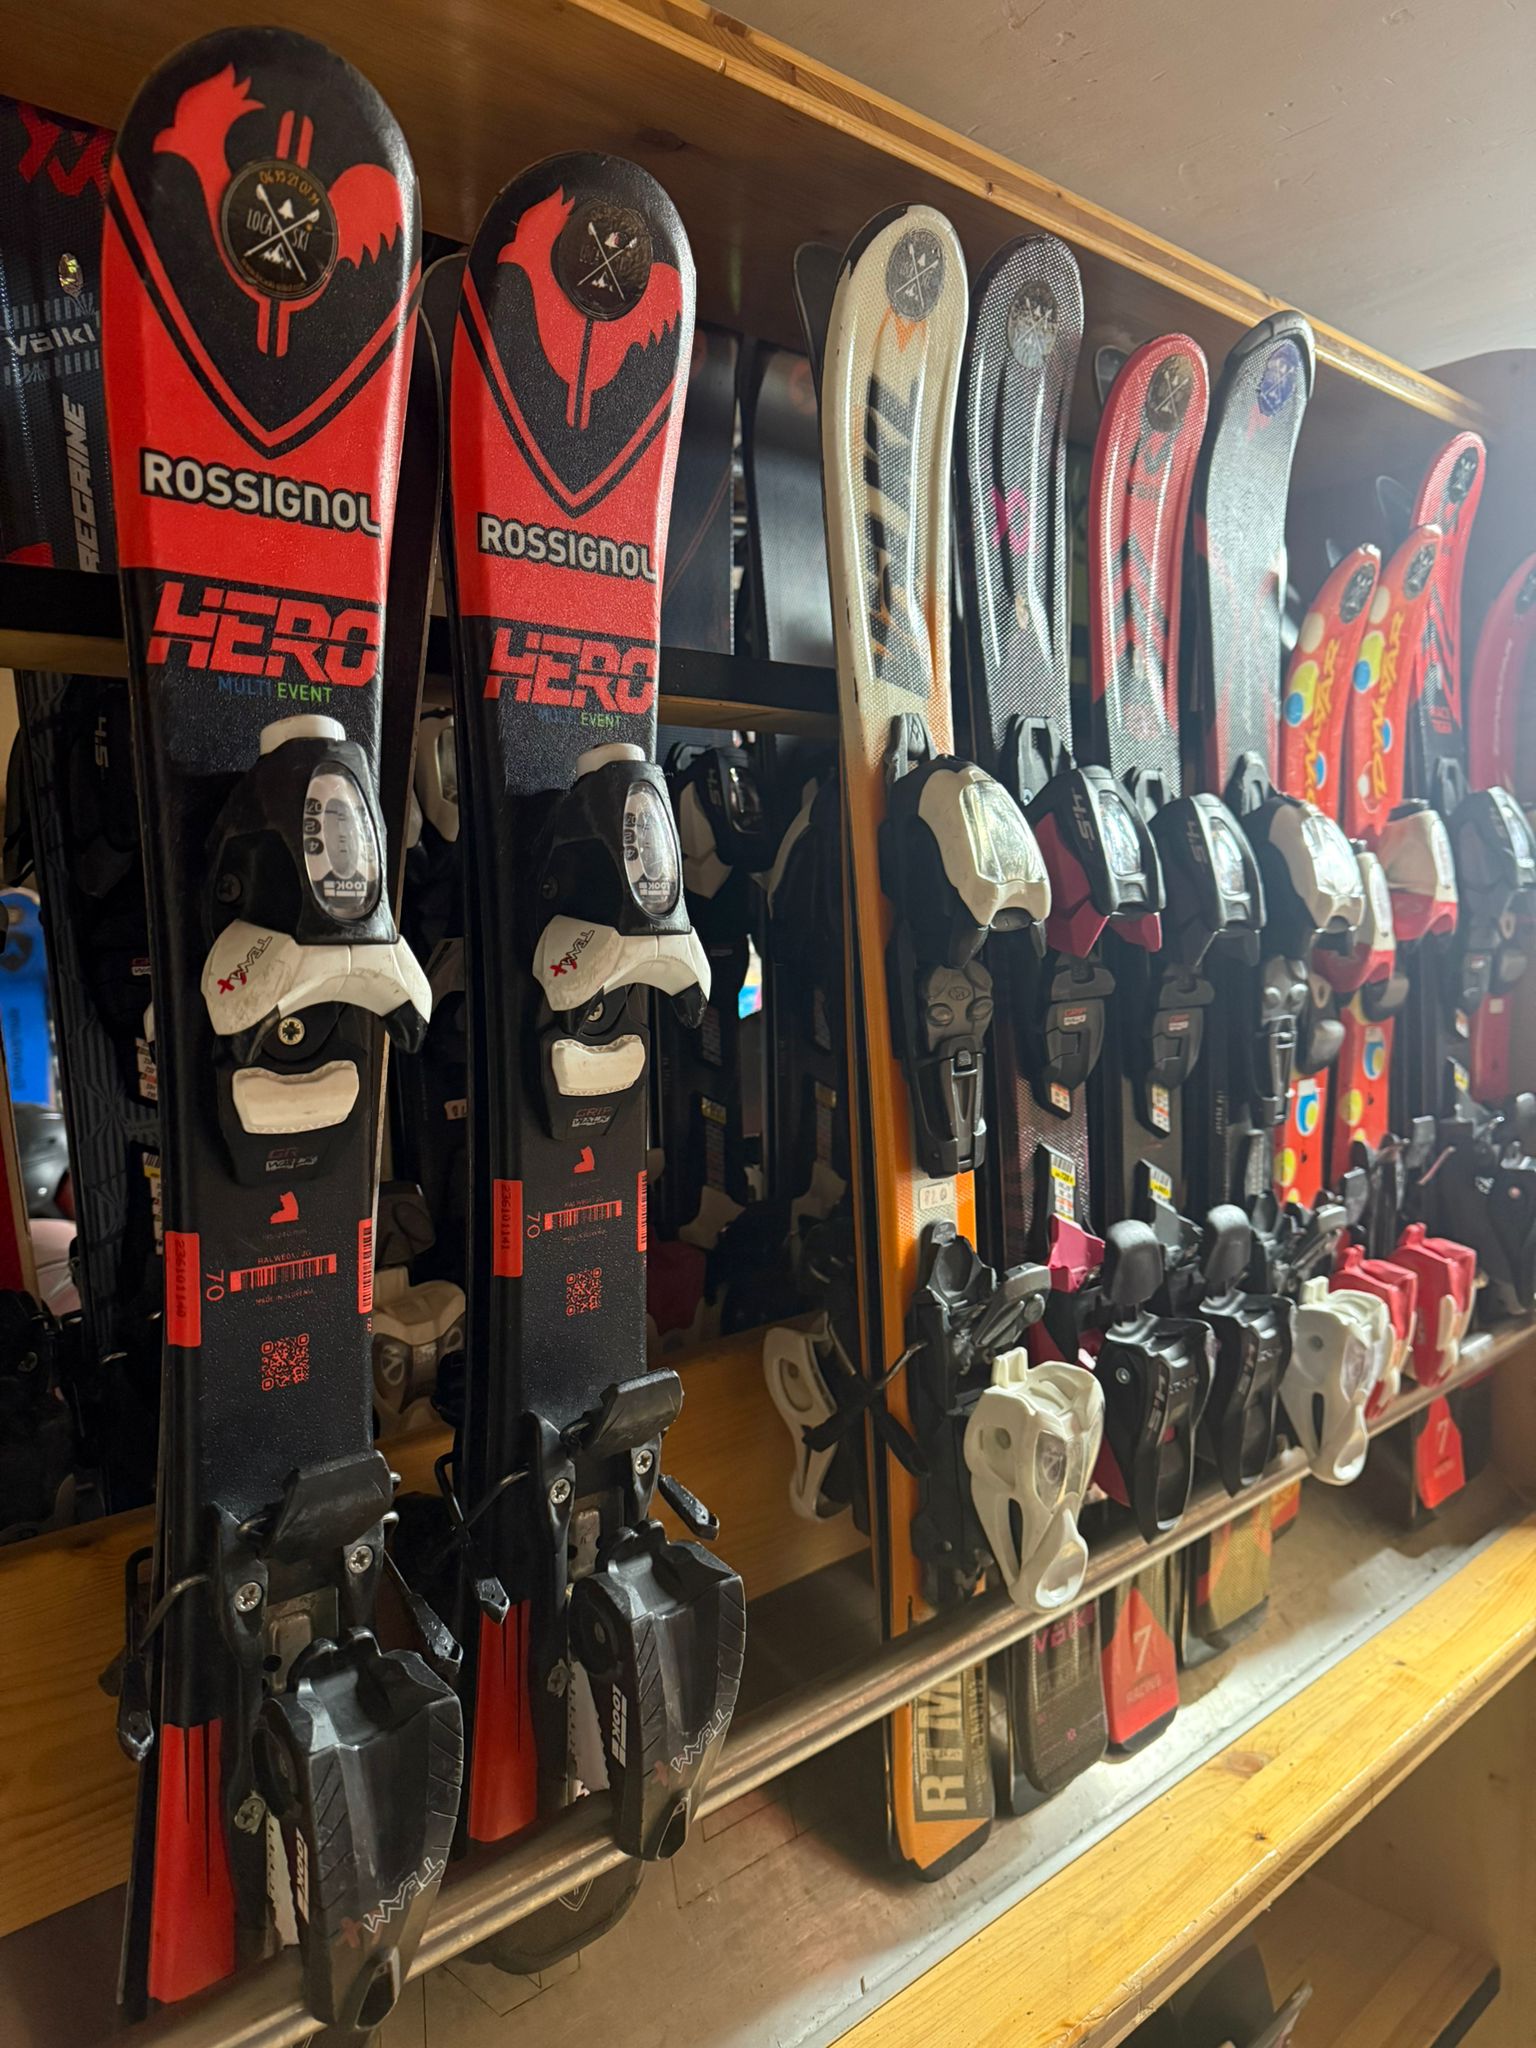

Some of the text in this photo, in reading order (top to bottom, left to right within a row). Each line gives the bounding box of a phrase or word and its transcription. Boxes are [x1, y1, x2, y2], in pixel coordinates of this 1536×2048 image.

[246, 208, 311, 252] LOCA SKI
[142, 450, 382, 537] ROSSIGNOL
[479, 515, 658, 582] ROSSIGNOL
[146, 581, 380, 687] HERO
[277, 682, 333, 704] EVENT
[483, 627, 659, 715] HERO
[580, 711, 622, 728] EVENT
[526, 1211, 541, 1239] 70
[205, 1267, 225, 1302] 70
[1132, 1623, 1152, 1674] 7
[611, 1683, 622, 1742] LOOK
[671, 1708, 733, 1775] TEAM
[363, 1856, 445, 1934] TEAM
